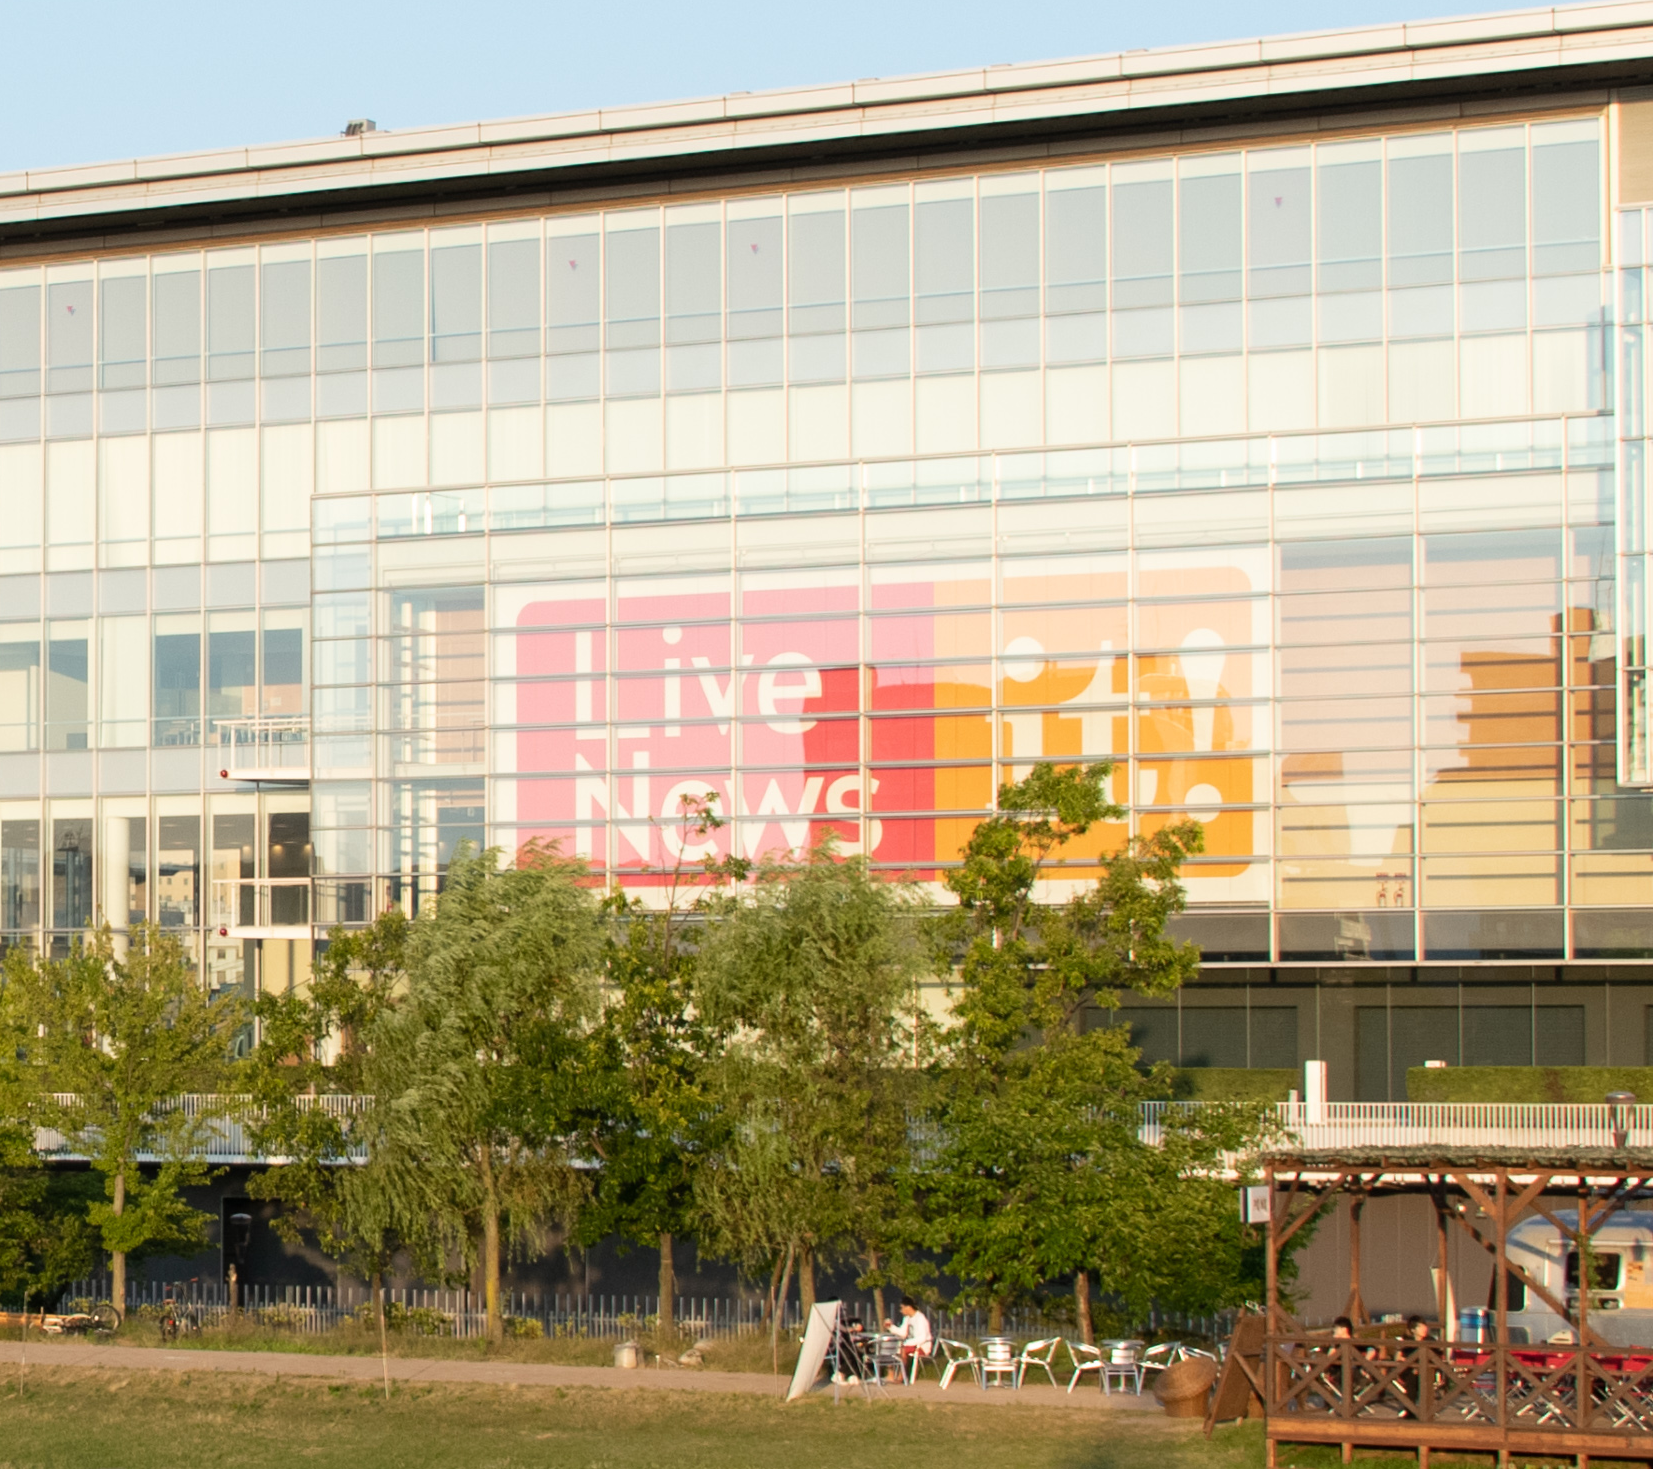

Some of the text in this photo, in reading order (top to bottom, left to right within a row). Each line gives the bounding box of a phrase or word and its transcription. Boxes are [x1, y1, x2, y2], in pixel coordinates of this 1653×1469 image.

[575, 624, 823, 742] Live
[983, 628, 1226, 823] it!
[573, 751, 883, 862] News
